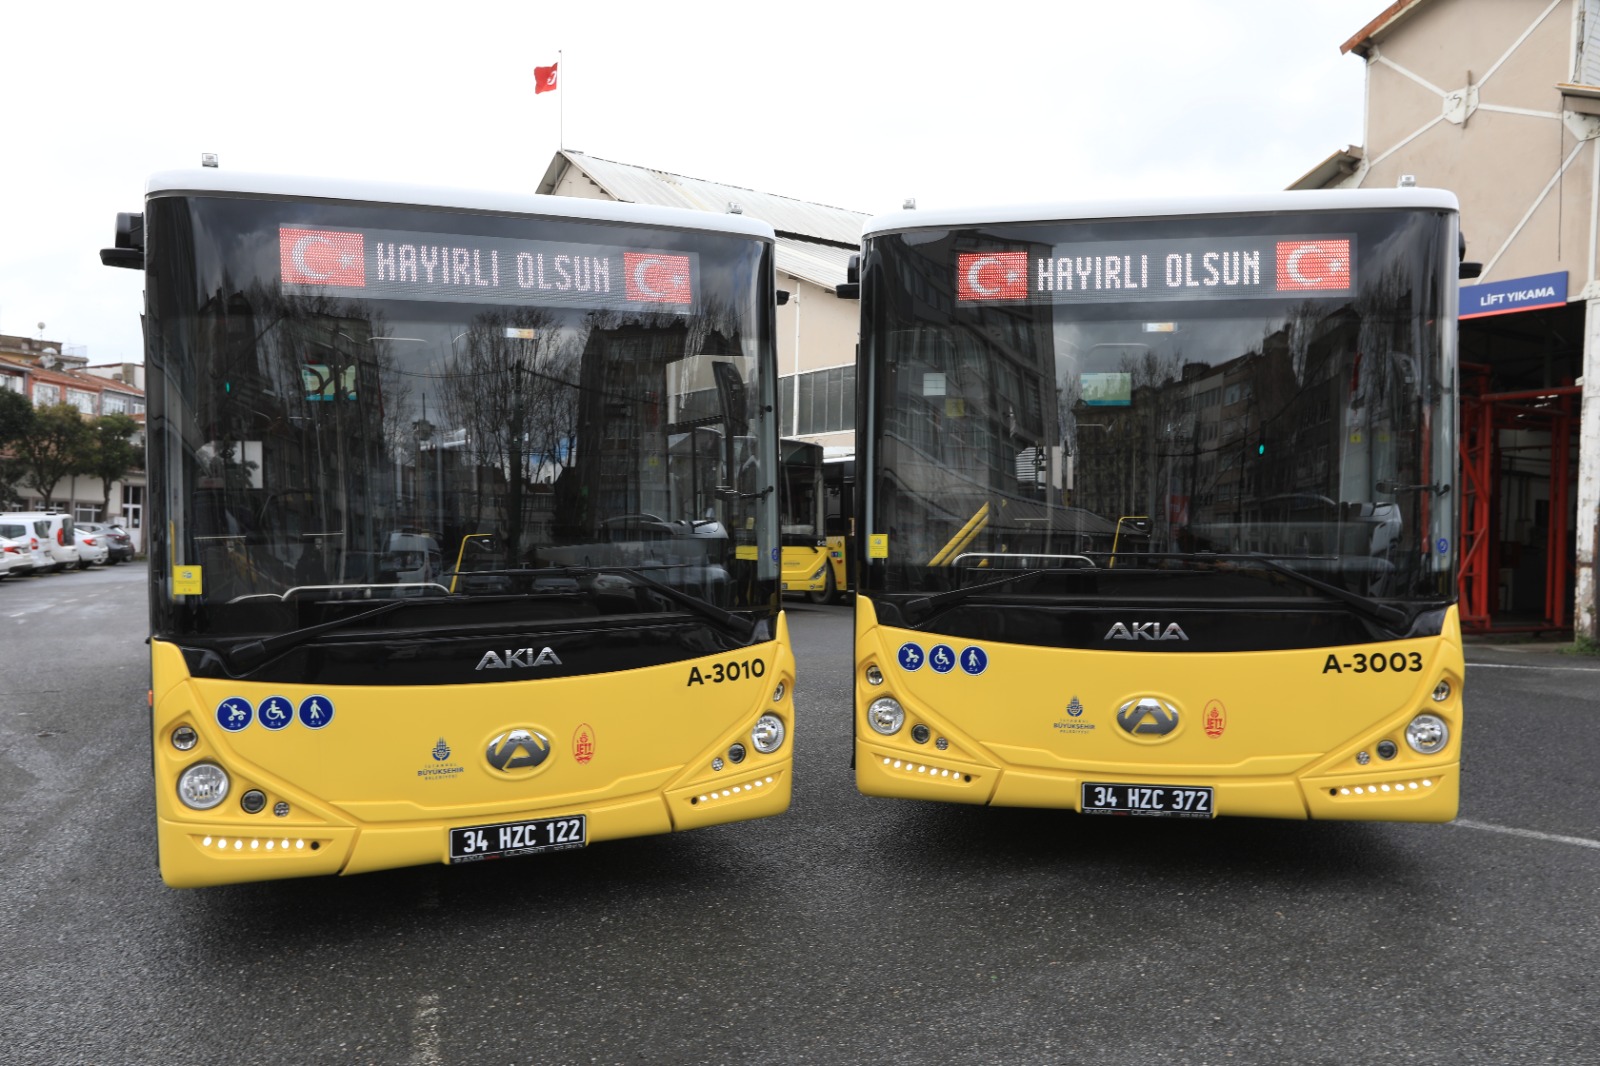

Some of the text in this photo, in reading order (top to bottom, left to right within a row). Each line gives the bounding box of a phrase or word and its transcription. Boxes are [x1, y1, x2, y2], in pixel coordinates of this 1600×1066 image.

[377, 243, 610, 292] HAYIRLI OLSUN
[1038, 250, 1260, 291] HAYIRLI OLSUN
[1480, 286, 1555, 306] LİFT YIKAMA
[1104, 621, 1190, 641] AKIA
[475, 646, 562, 671] AKIA
[1322, 652, 1424, 674] A-3003
[687, 658, 766, 687] A-3010
[1094, 787, 1208, 811] 34 HZC 372
[463, 830, 488, 853] 34
[499, 824, 537, 849] HZC
[546, 819, 580, 843] 122
